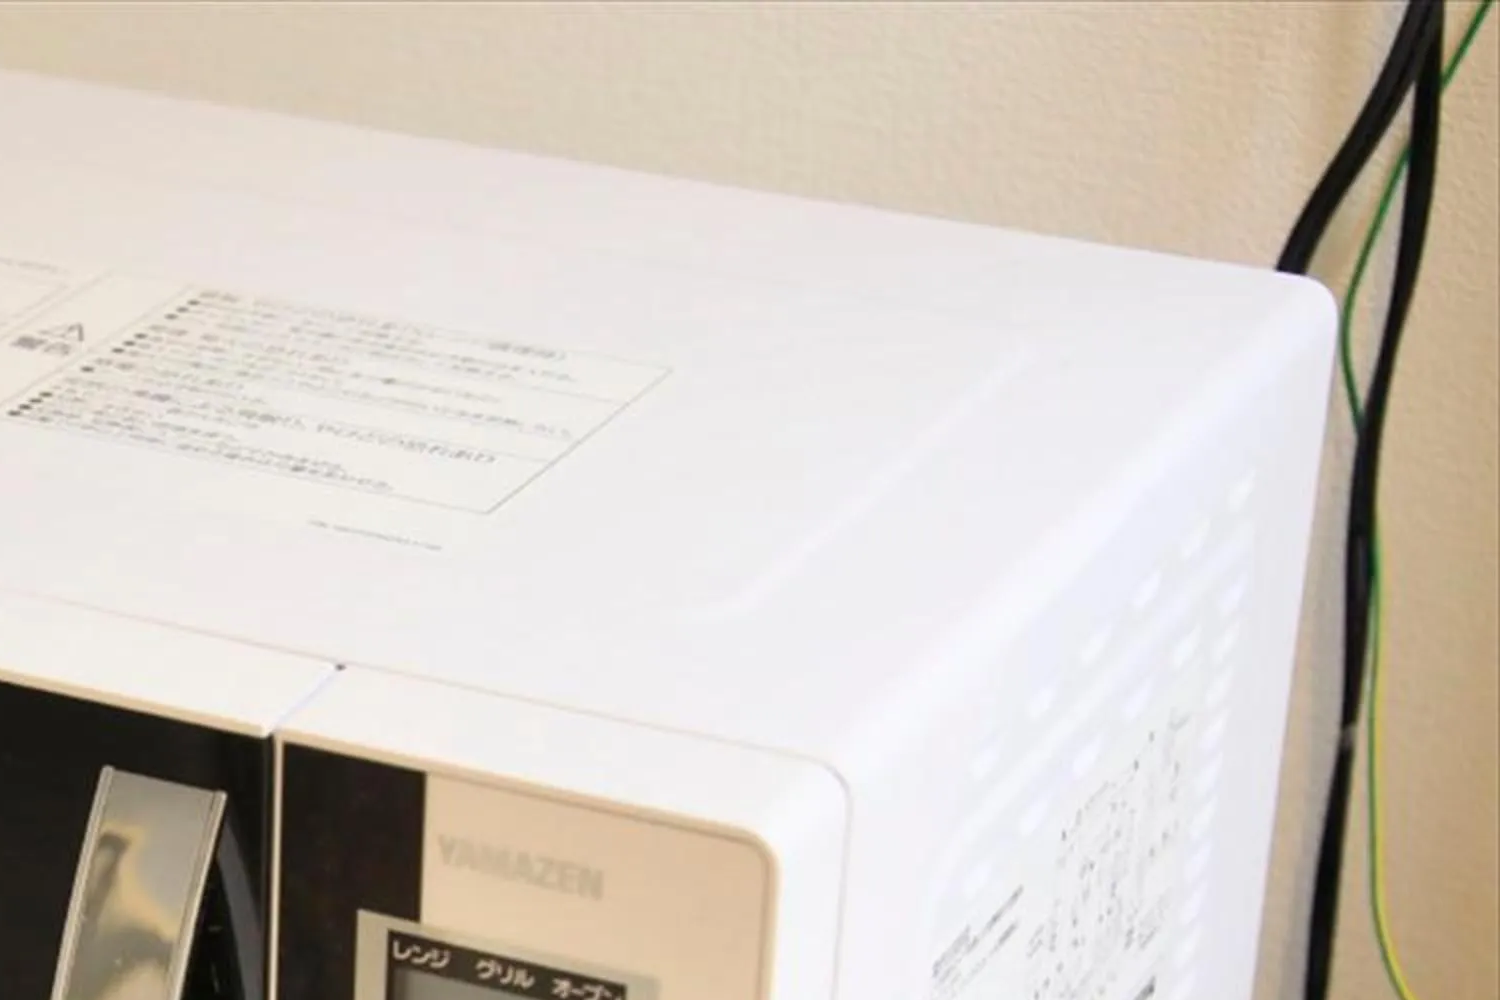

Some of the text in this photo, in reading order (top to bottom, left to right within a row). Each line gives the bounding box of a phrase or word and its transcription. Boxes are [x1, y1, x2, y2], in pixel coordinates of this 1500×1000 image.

[436, 833, 606, 900] YAMAZEN
[392, 937, 451, 970] レンジ
[474, 957, 536, 991] グリル
